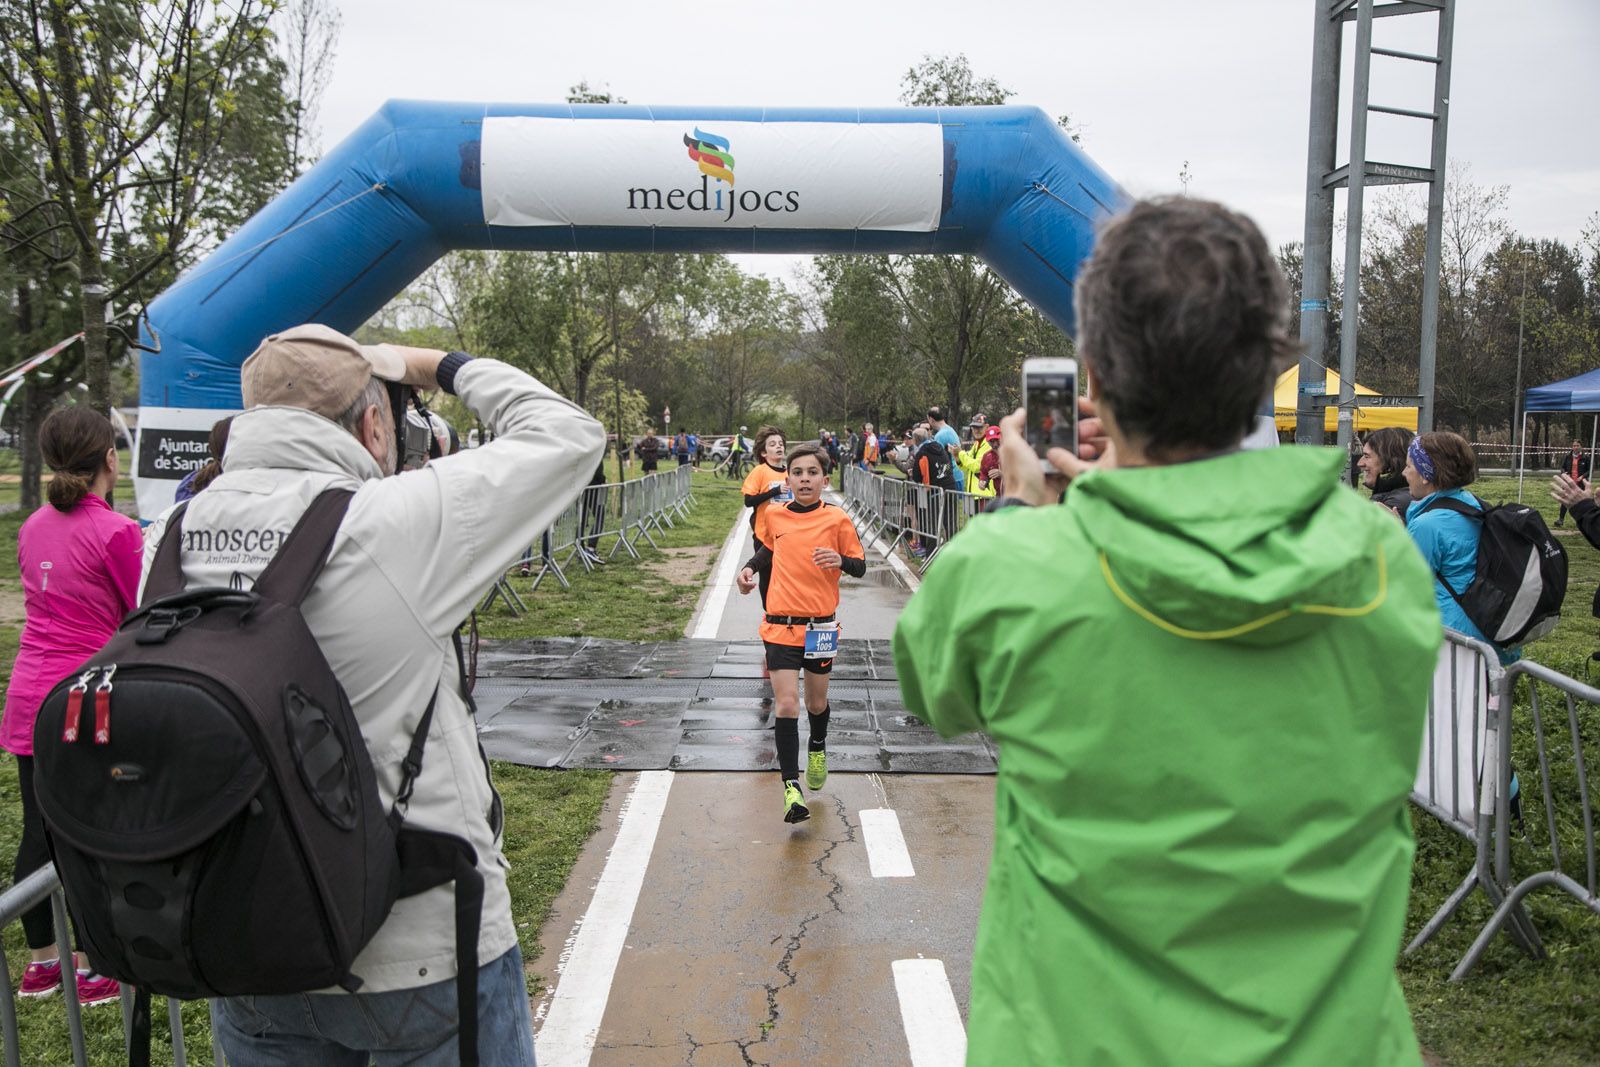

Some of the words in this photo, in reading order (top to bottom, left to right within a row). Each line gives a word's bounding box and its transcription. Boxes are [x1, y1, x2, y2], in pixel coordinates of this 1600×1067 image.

[627, 174, 799, 222] medijocs
[154, 456, 171, 469] de
[205, 552, 240, 564] Animal
[816, 632, 832, 644] JAN
[816, 642, 833, 651] 1009
